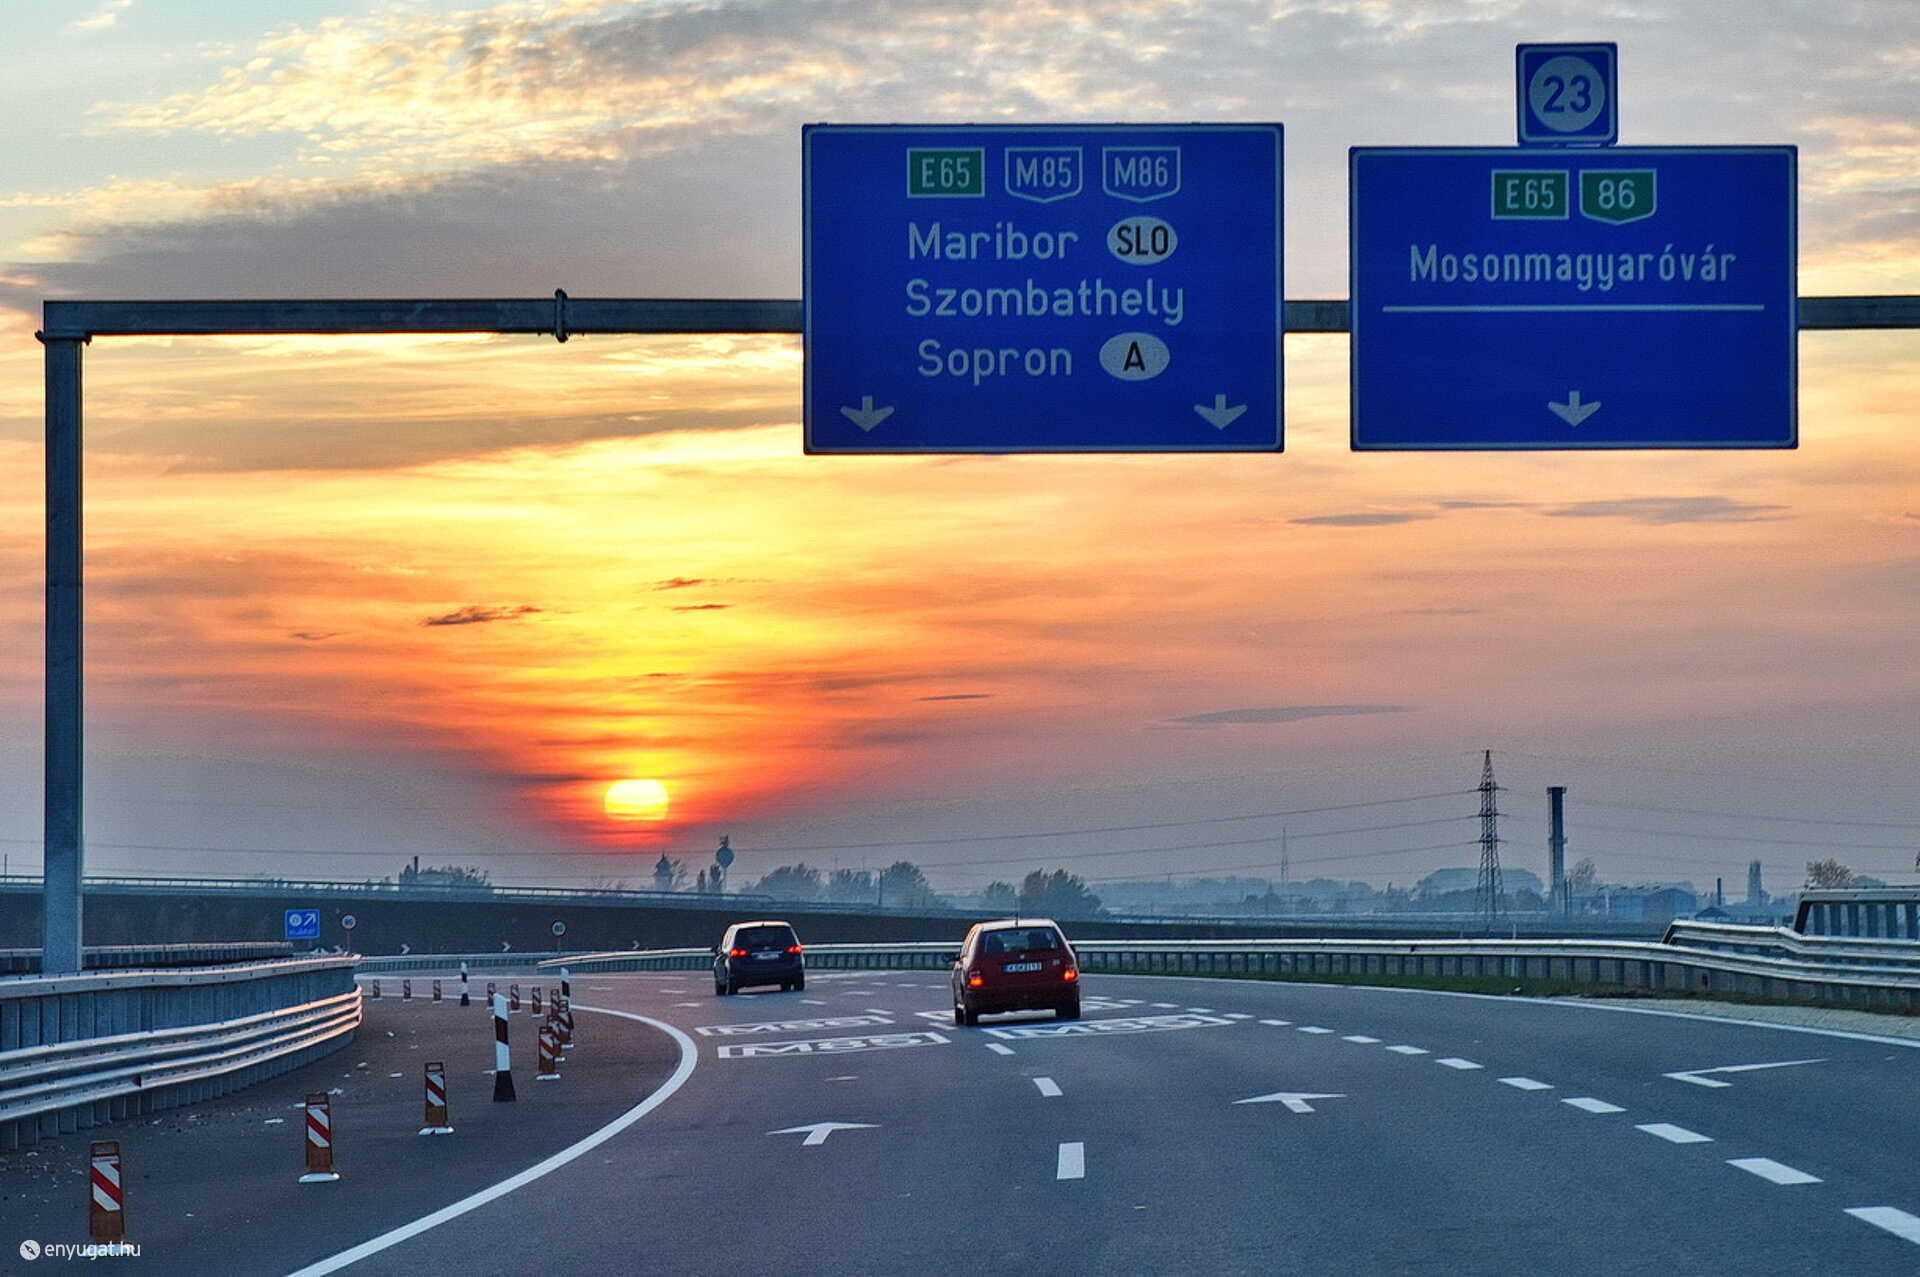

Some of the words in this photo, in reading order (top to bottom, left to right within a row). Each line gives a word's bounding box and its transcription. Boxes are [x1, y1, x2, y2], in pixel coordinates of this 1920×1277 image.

[1542, 74, 1592, 113] 23
[921, 157, 971, 188] E65
[1015, 156, 1073, 188] M85
[1113, 156, 1169, 187] M86
[1505, 179, 1555, 209] E65
[1598, 180, 1636, 209] 86
[908, 221, 1079, 261] Maribor
[1116, 224, 1169, 256] SLO
[1409, 244, 1737, 291] Mosonmagyaróvár
[905, 278, 1185, 327] Szombathely
[917, 339, 1073, 386] Sopron
[1122, 342, 1146, 373] A
